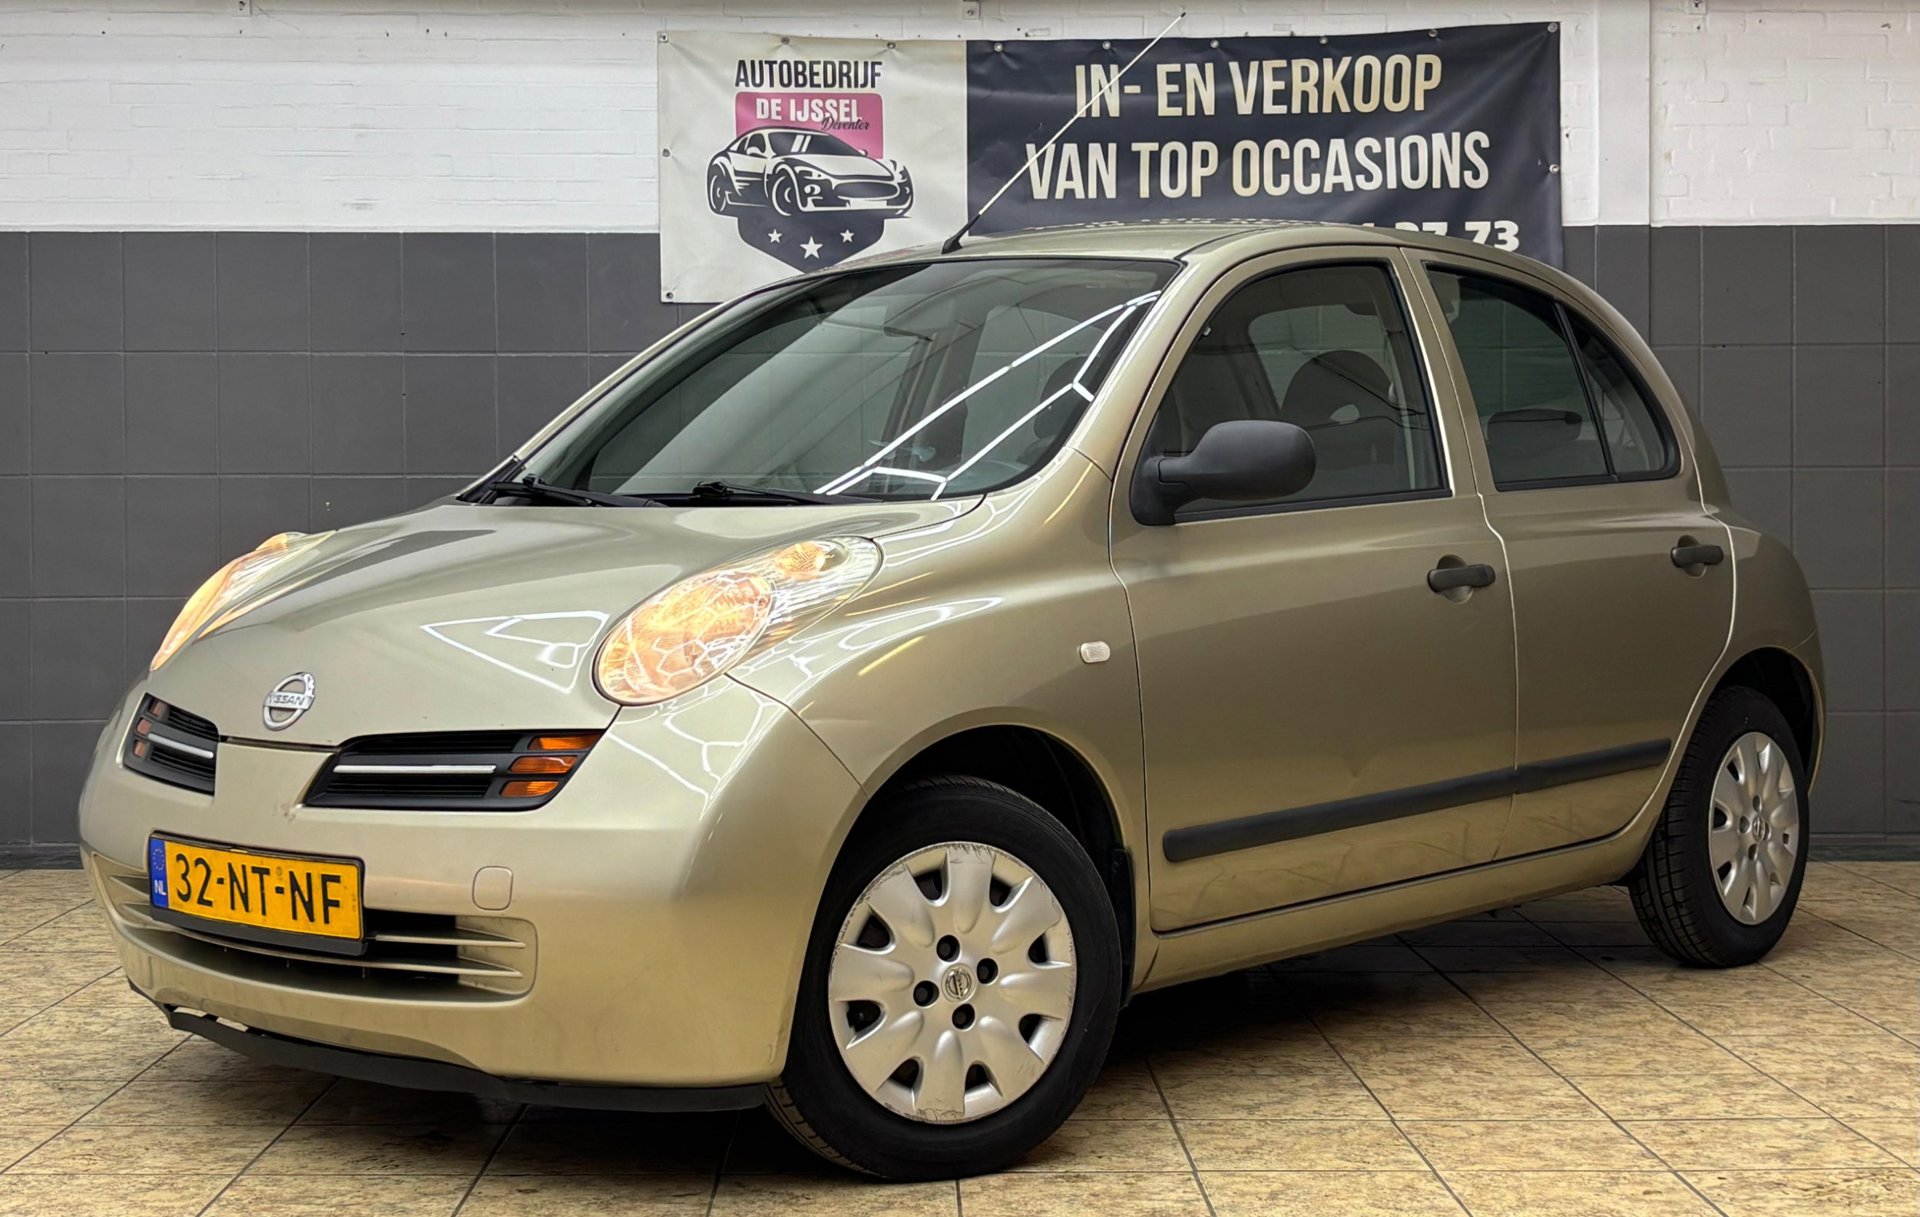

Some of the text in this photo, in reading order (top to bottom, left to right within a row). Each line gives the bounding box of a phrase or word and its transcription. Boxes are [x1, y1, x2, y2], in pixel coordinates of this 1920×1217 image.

[735, 60, 883, 89] AUTOBEDRIJF
[1075, 54, 1442, 118] IN- EN VERKOOP
[756, 98, 863, 123] DE IJSSEL
[821, 115, 871, 131] Deventer
[1026, 131, 1490, 200] VAN TOP OCCASIONS
[1464, 220, 1520, 252] 73
[154, 880, 167, 896] NL
[175, 853, 341, 925] 32-NT-NF
